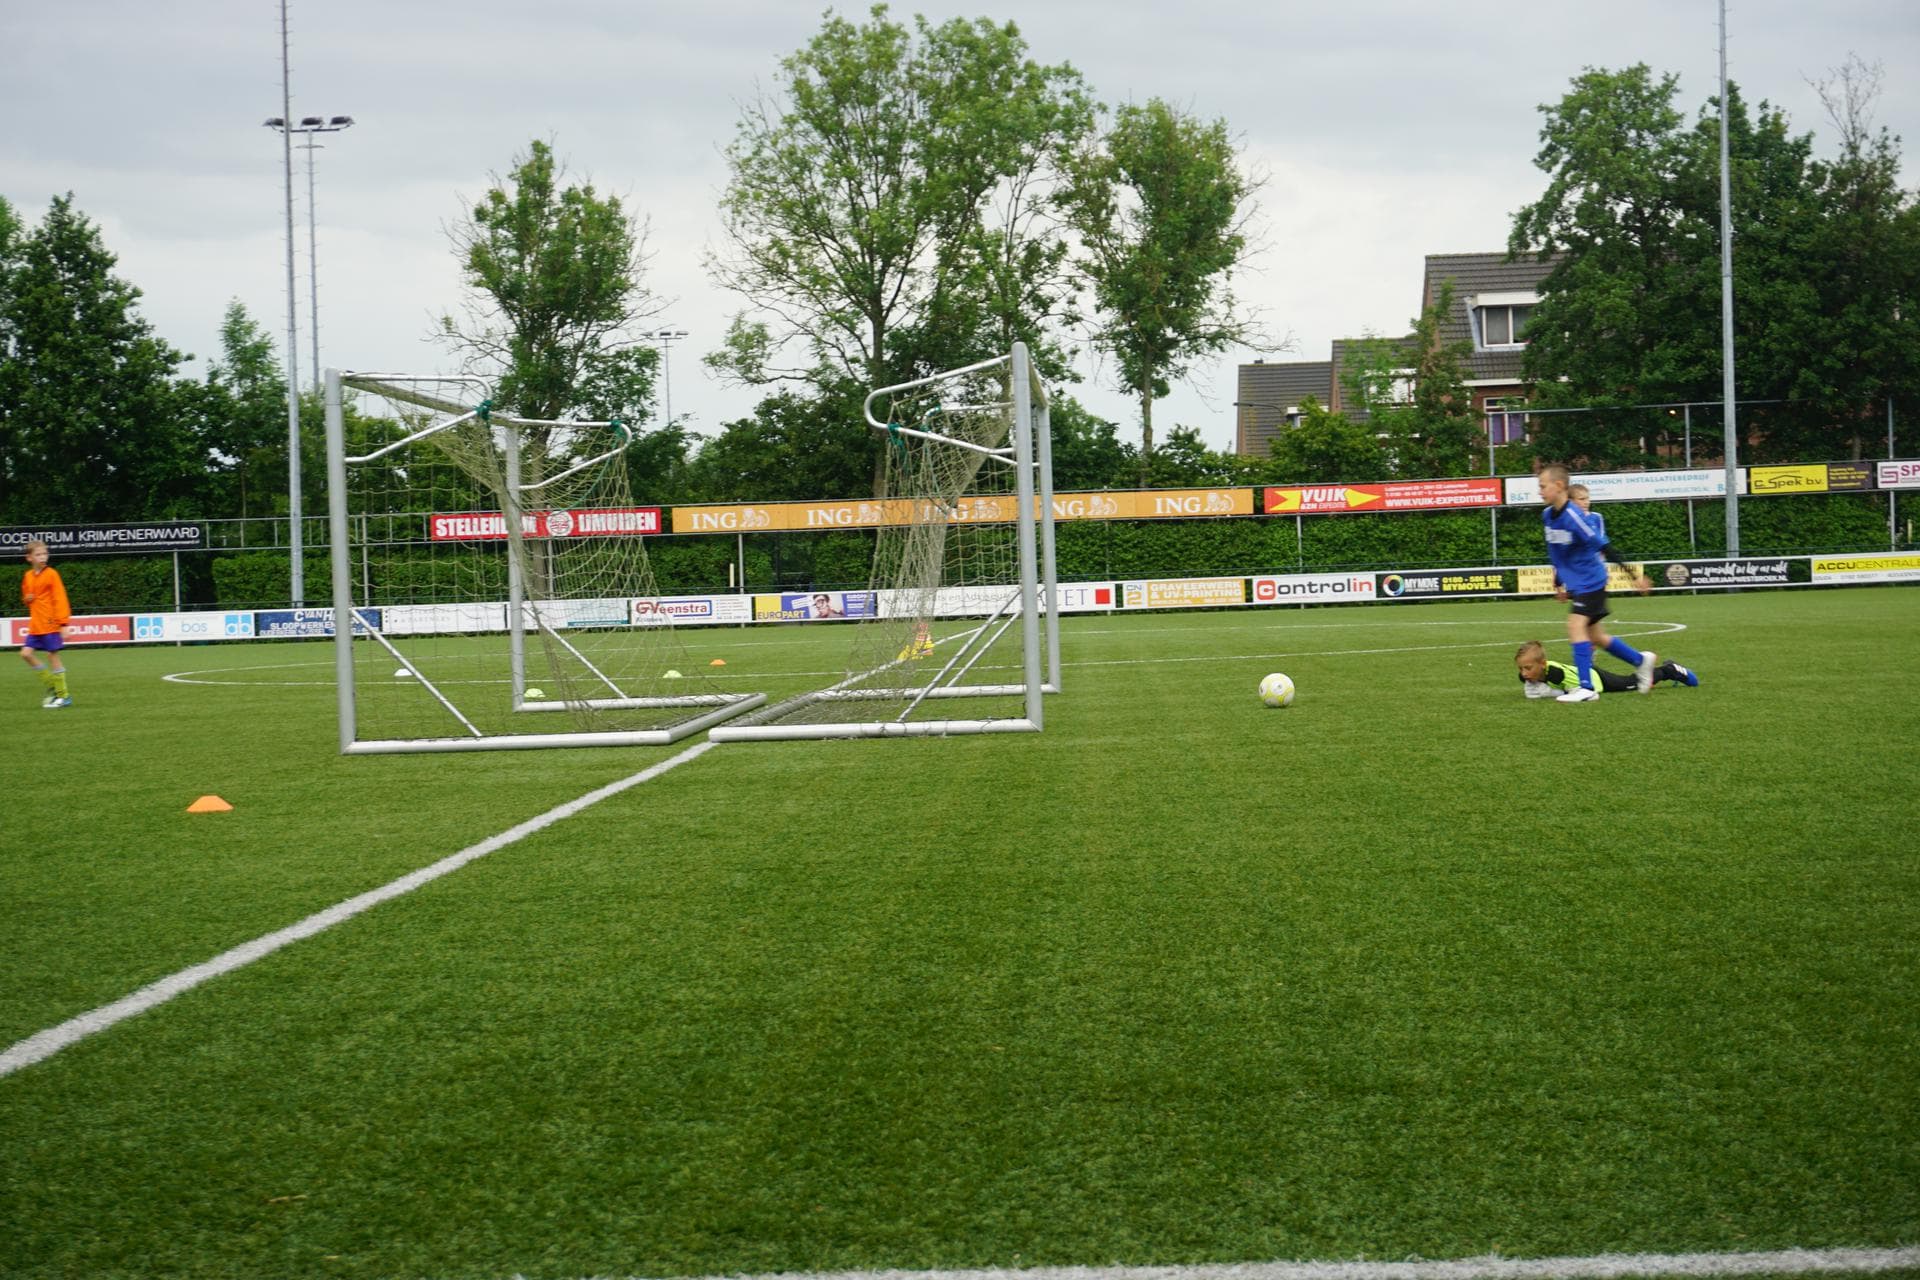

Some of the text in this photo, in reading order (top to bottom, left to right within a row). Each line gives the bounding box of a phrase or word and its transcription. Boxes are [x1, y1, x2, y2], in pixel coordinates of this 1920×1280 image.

[1301, 488, 1347, 502] VUIK
[1385, 494, 1499, 507] WWW.VUIK-EXPEDITIE.NL
[1052, 499, 1085, 516] NG
[1154, 496, 1202, 513] ING
[578, 512, 657, 532] IJMUIDEN
[691, 512, 737, 529] ING
[807, 508, 853, 525] ING
[79, 527, 200, 541] KRIMPENERWAARD
[1442, 581, 1503, 591] MYMOVE.NL
[757, 610, 806, 620] EUROPART
